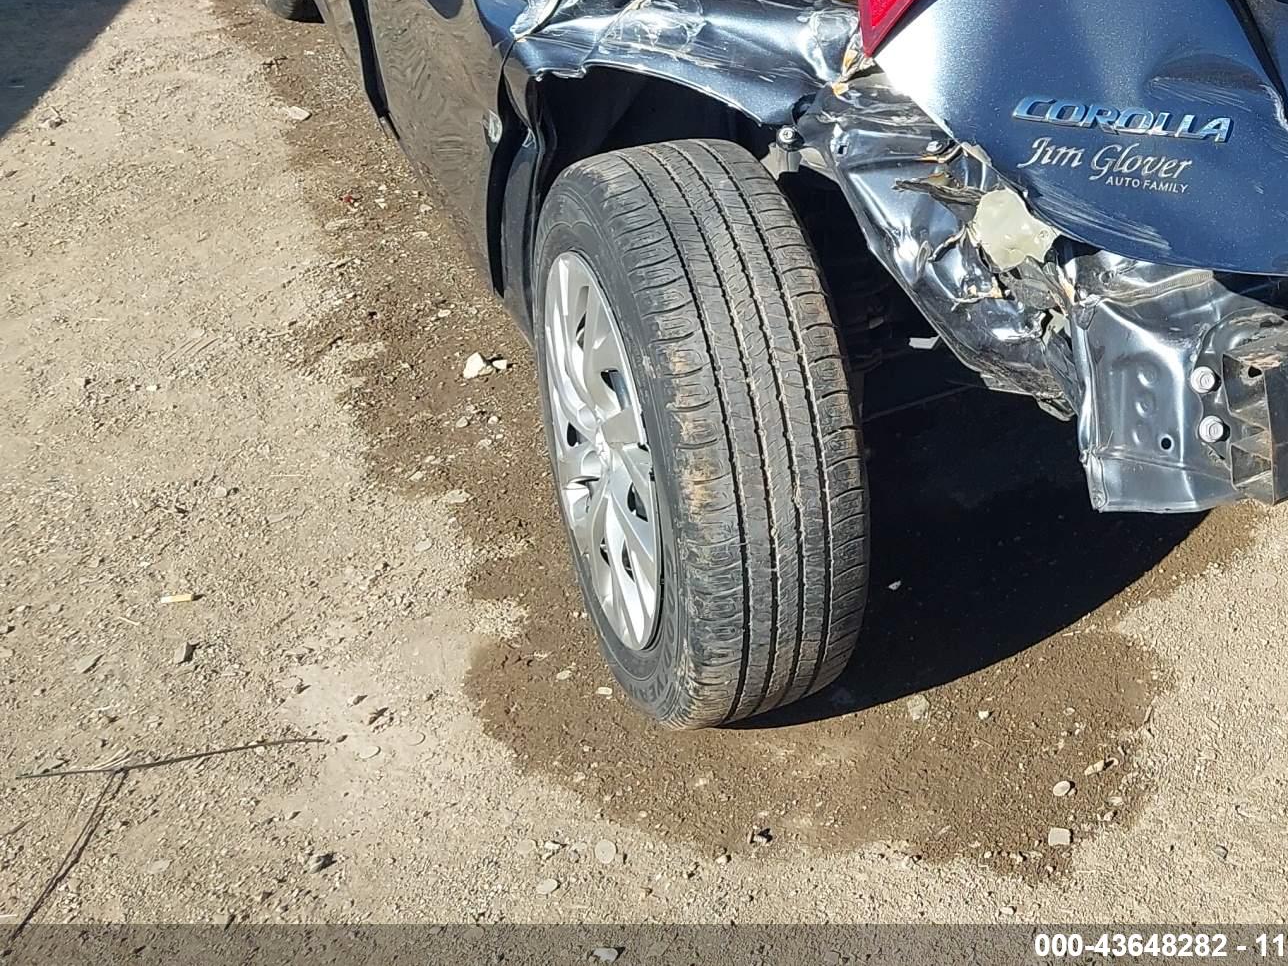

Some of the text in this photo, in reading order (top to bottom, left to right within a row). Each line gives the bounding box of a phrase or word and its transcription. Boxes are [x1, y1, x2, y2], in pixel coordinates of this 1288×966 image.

[1012, 96, 1235, 143] COROLLA
[1017, 137, 1193, 181] Jim Glover
[1105, 176, 1189, 195] AUTO FAMILY
